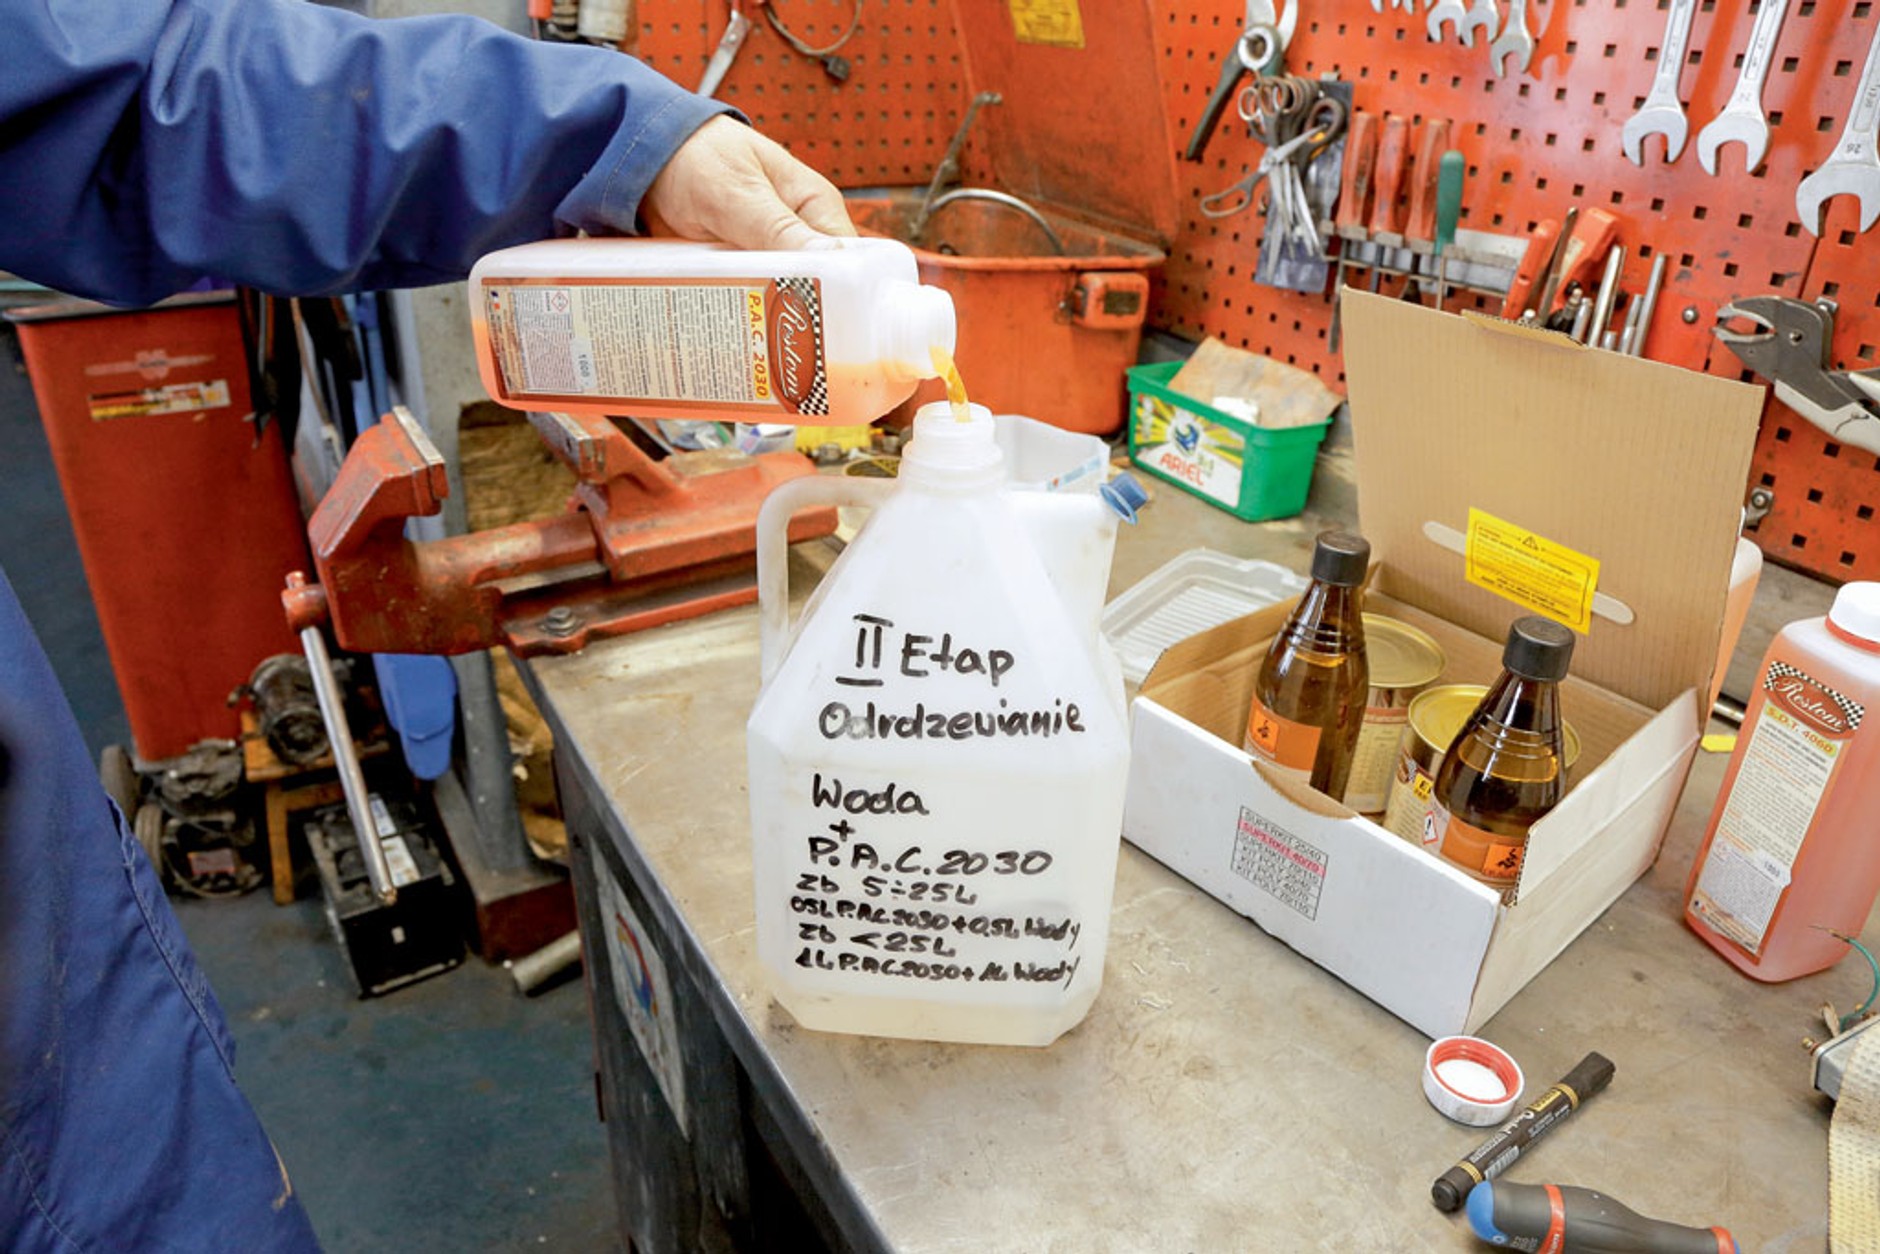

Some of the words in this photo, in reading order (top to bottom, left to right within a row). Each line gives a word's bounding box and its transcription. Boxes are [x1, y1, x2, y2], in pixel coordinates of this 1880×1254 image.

[753, 351, 768, 397] 2030
[1160, 452, 1204, 485] ARIEL
[900, 632, 1016, 688] Etap
[1774, 679, 1843, 732] Restom
[812, 773, 930, 816] Woda
